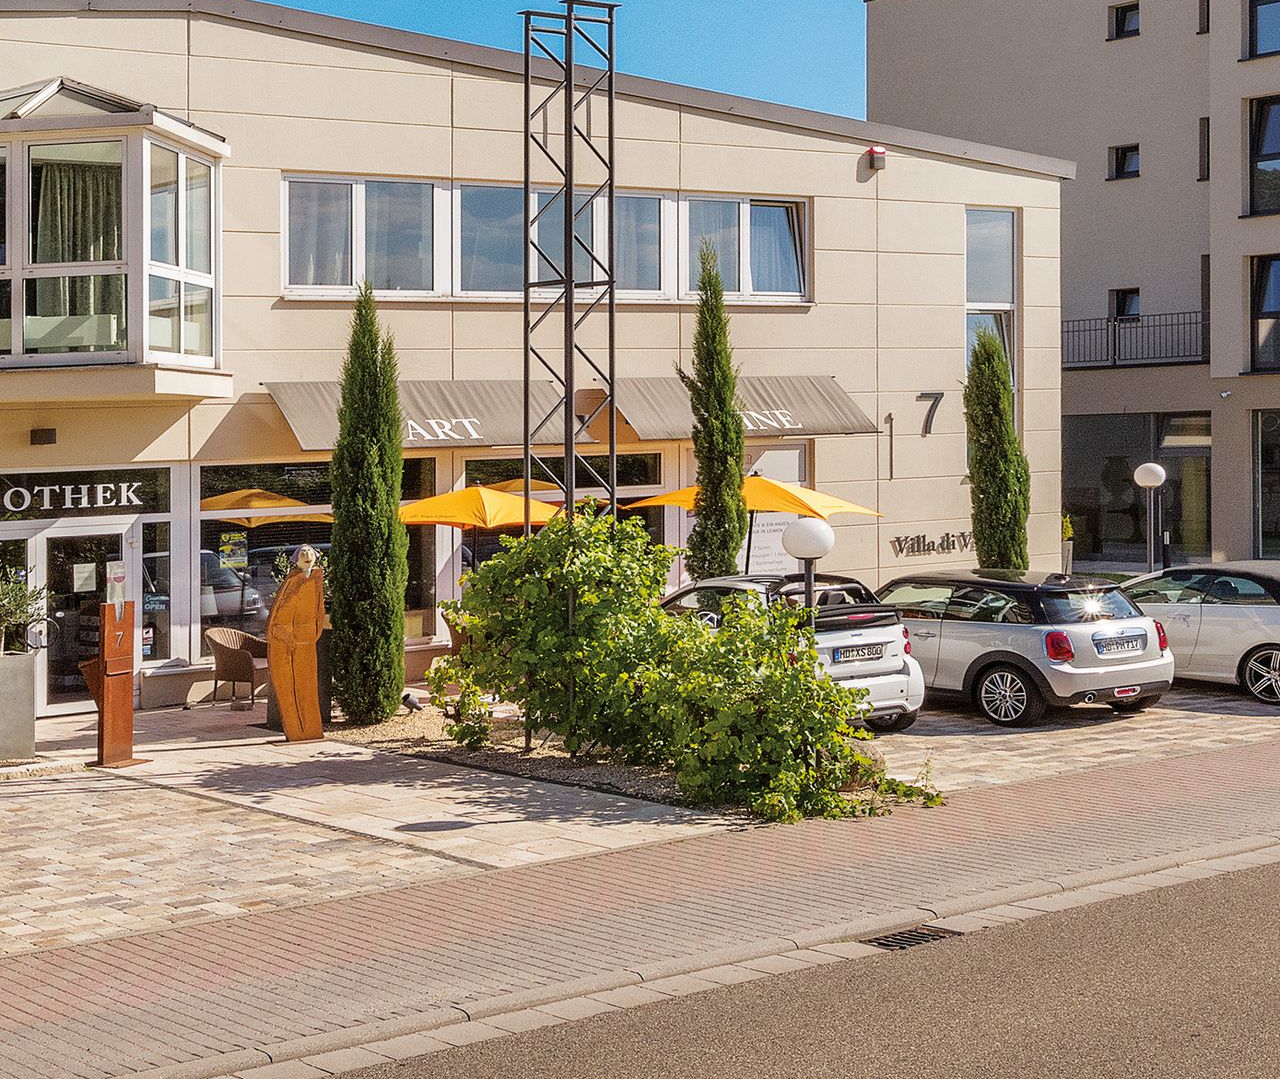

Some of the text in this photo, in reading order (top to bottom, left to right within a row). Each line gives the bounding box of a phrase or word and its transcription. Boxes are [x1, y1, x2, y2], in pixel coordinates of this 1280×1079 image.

[733, 410, 803, 430] INE
[920, 393, 944, 434] 7
[406, 418, 484, 440] ART
[895, 534, 936, 554] Villa
[938, 532, 956, 551] di
[116, 632, 124, 647] 7
